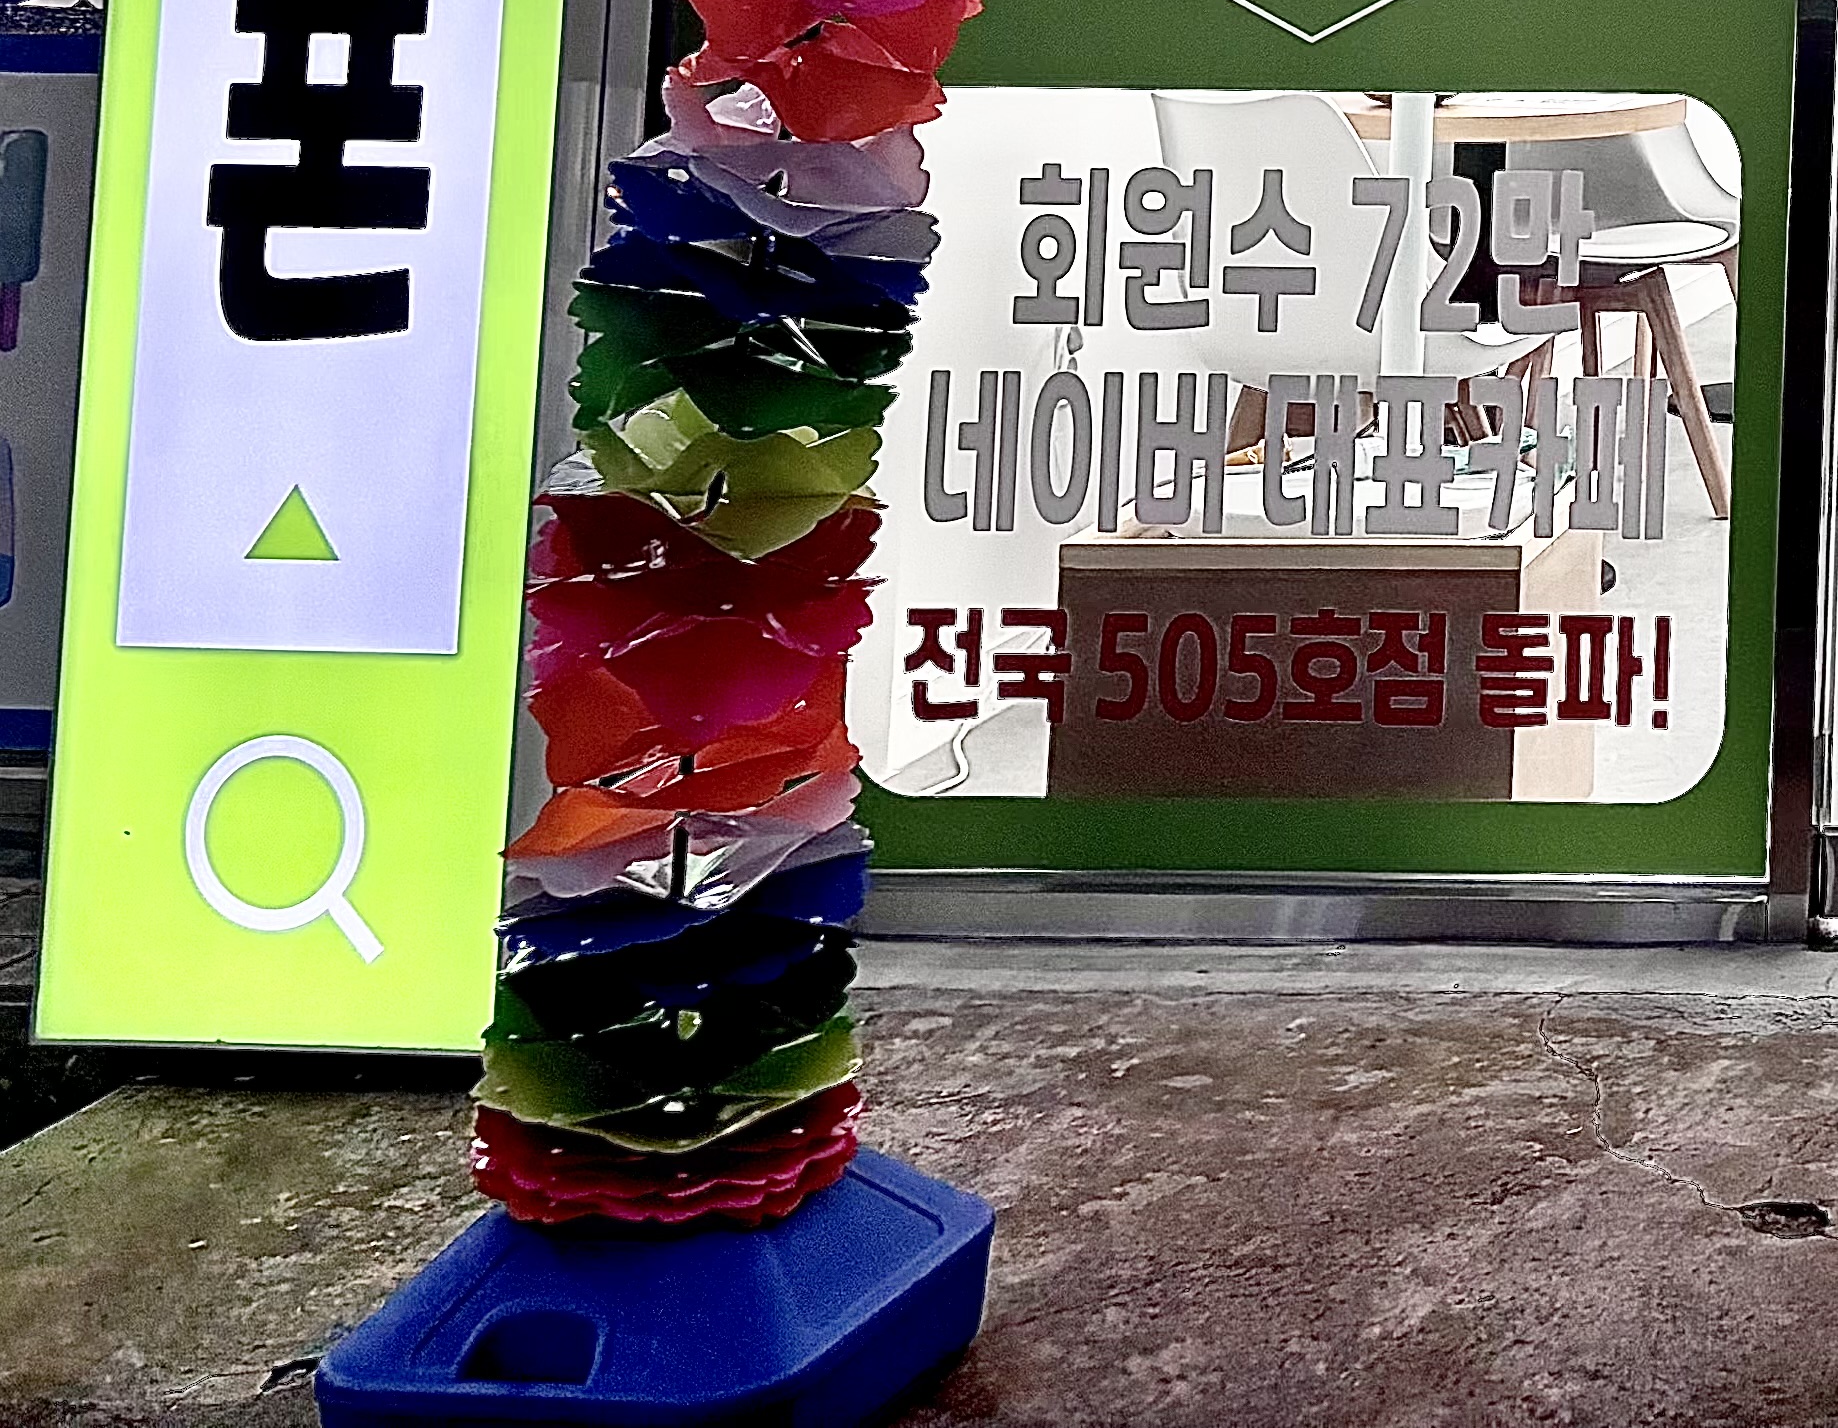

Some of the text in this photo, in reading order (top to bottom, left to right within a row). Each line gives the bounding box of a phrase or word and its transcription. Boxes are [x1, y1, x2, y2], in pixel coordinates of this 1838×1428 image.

[1012, 162, 1595, 335] 회원수 72만
[926, 369, 1229, 533] 네이버
[903, 607, 1673, 730] 전국 505호점 돌파!
